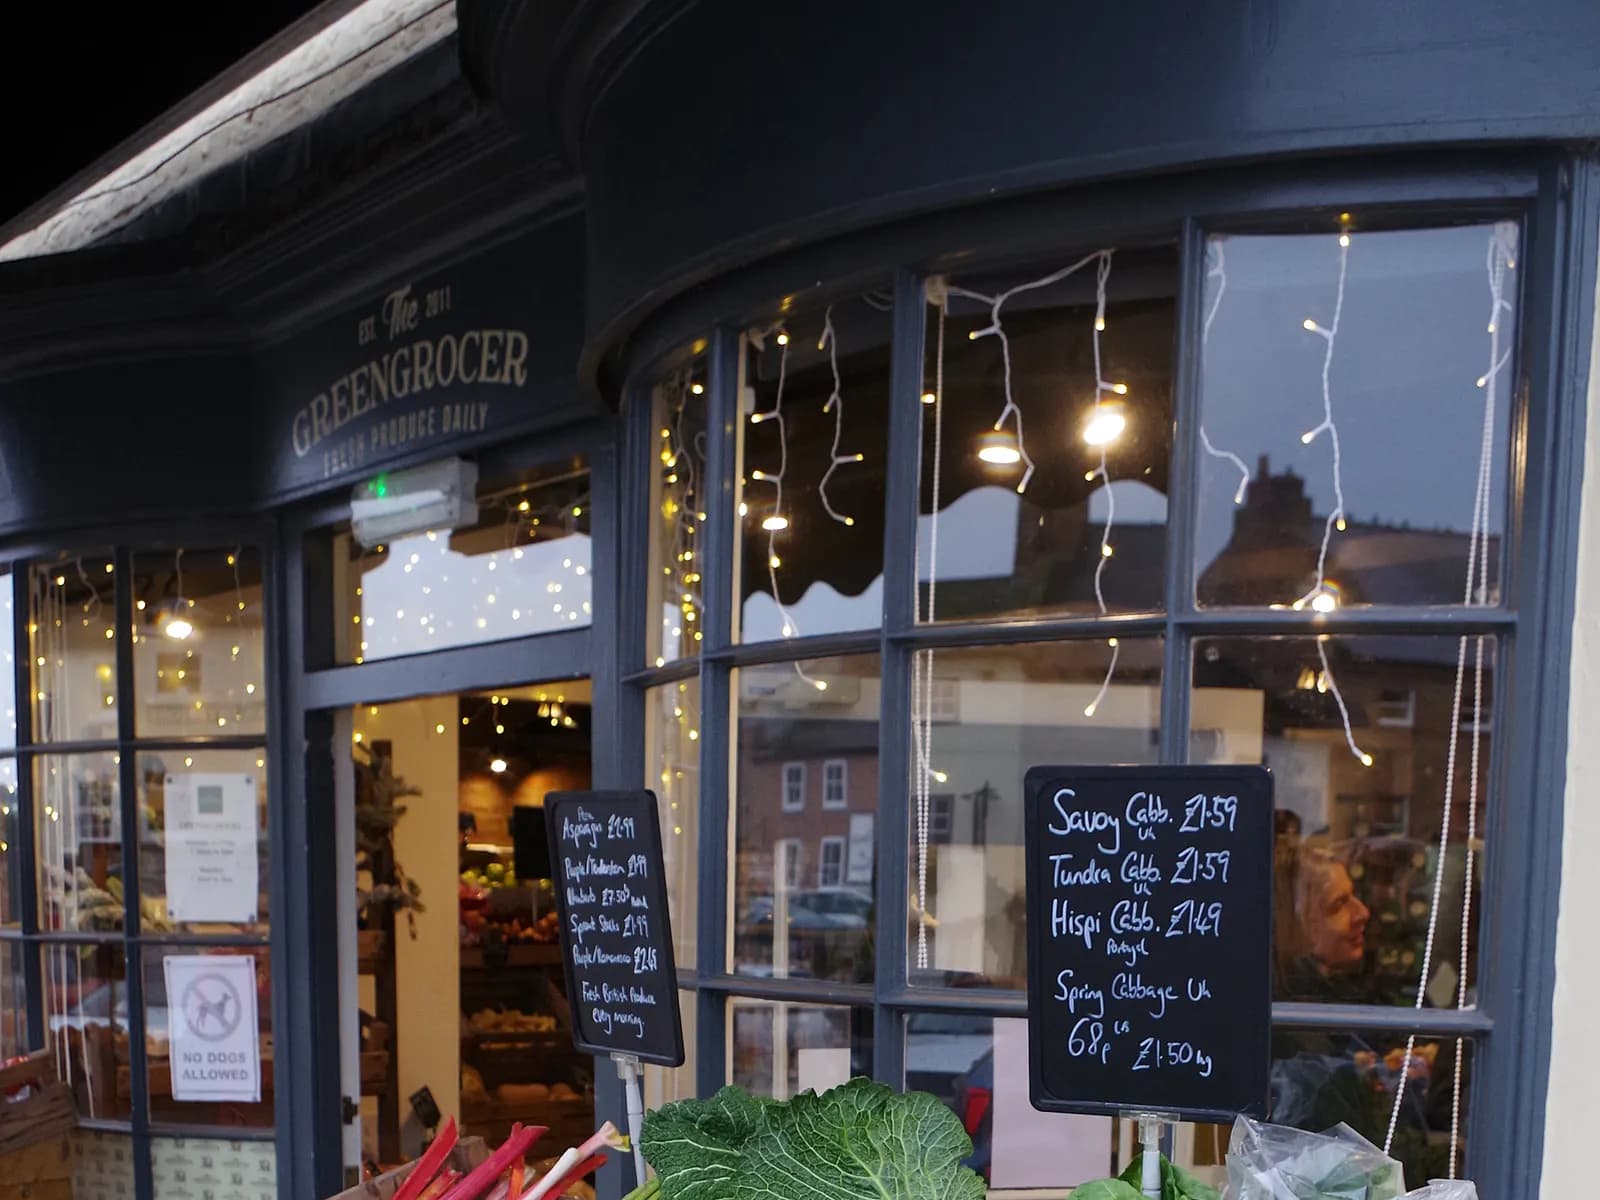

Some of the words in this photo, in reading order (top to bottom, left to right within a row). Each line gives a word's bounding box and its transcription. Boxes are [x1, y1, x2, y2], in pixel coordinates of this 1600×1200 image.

[382, 285, 418, 341] The
[292, 328, 528, 458] GREENGROCER
[370, 408, 436, 452] PRODUCE
[441, 401, 489, 435] DAILY
[1049, 788, 1121, 854] Savoy
[1125, 791, 1174, 827] Cabb.
[1178, 793, 1238, 833] £1.59
[1049, 854, 1112, 890] Tundra
[1119, 850, 1162, 884] Cabb.
[1169, 846, 1231, 885] £1.59
[570, 913, 596, 944] Sprout
[622, 913, 649, 938] £1.99
[1050, 898, 1102, 949] Hispi
[1109, 899, 1160, 935] Cabb.
[1164, 899, 1223, 938] £1.49
[582, 980, 601, 1003] Fresh
[602, 982, 628, 1004] British
[1053, 968, 1105, 1019] Spring
[1111, 972, 1179, 1019] Cabbage
[182, 1069, 249, 1081] ALLOWED
[183, 1052, 203, 1064] NO
[207, 1052, 246, 1064] DOGS
